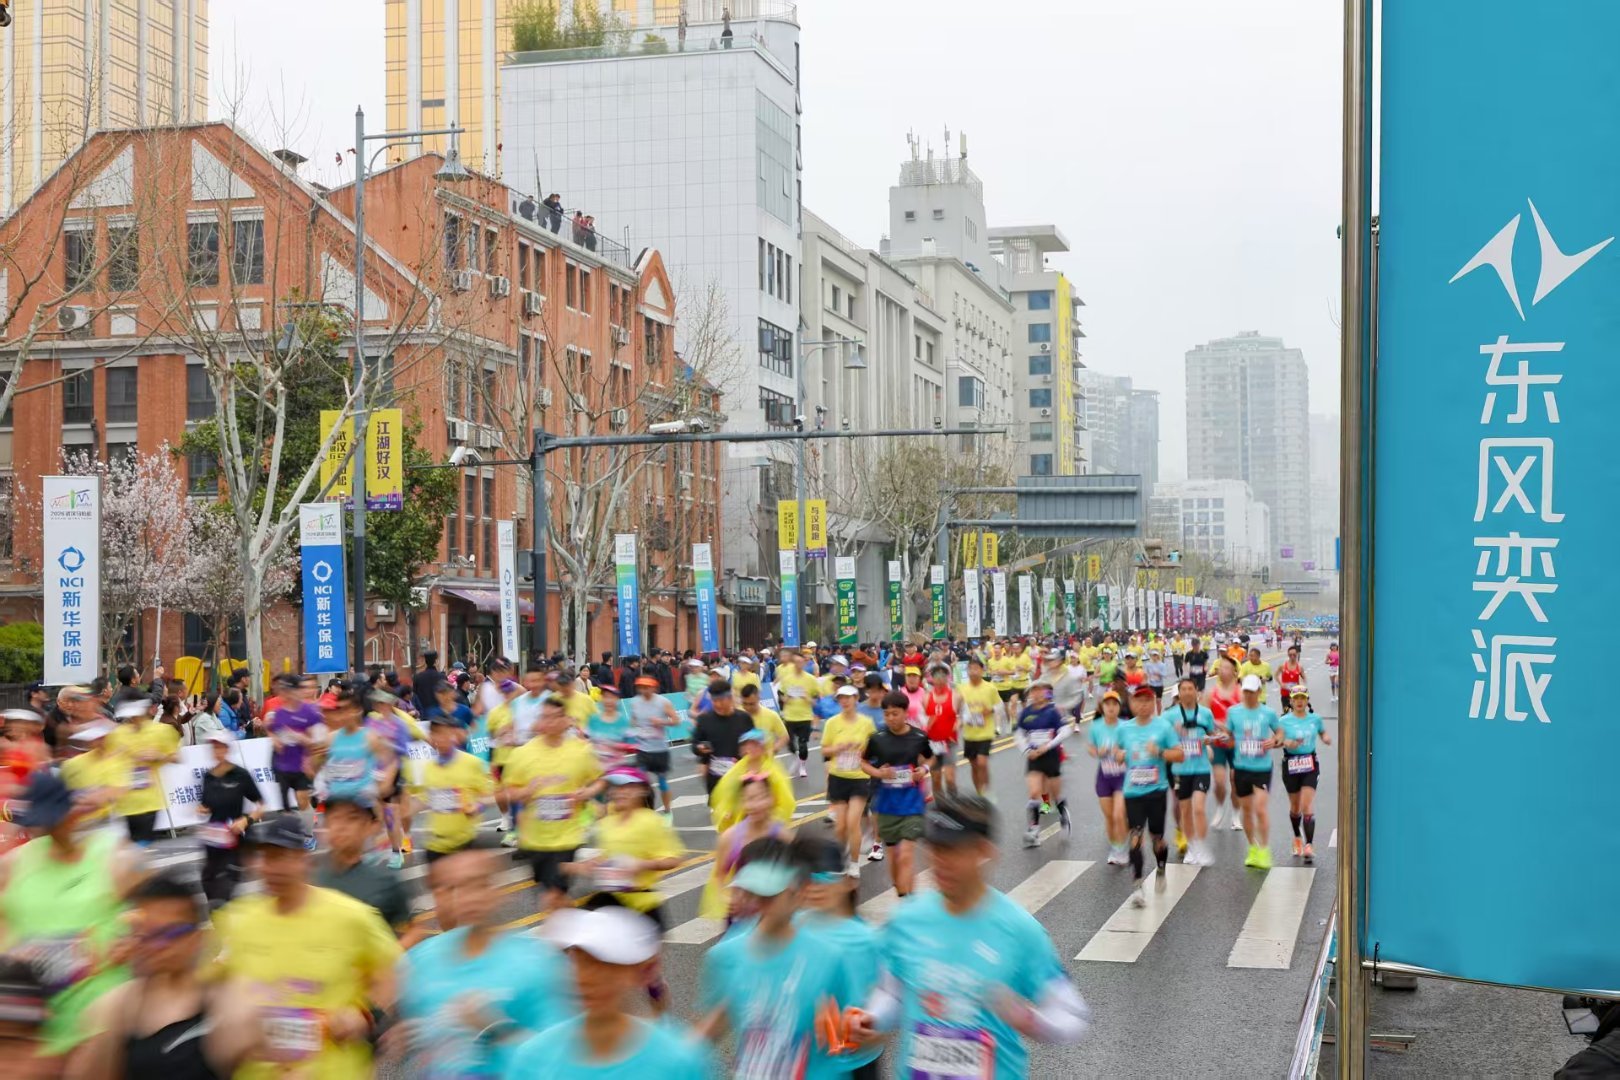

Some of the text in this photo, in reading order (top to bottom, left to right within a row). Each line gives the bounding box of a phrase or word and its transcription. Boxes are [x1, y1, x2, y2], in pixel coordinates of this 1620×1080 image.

[336, 430, 347, 487] 武汉马松
[376, 420, 391, 480] 江湖好汉
[1468, 335, 1566, 723] 东风奕派
[60, 577, 84, 588] NCI
[314, 585, 332, 595] NCI
[62, 591, 82, 667] 新华保险
[316, 597, 333, 659] 新华保险
